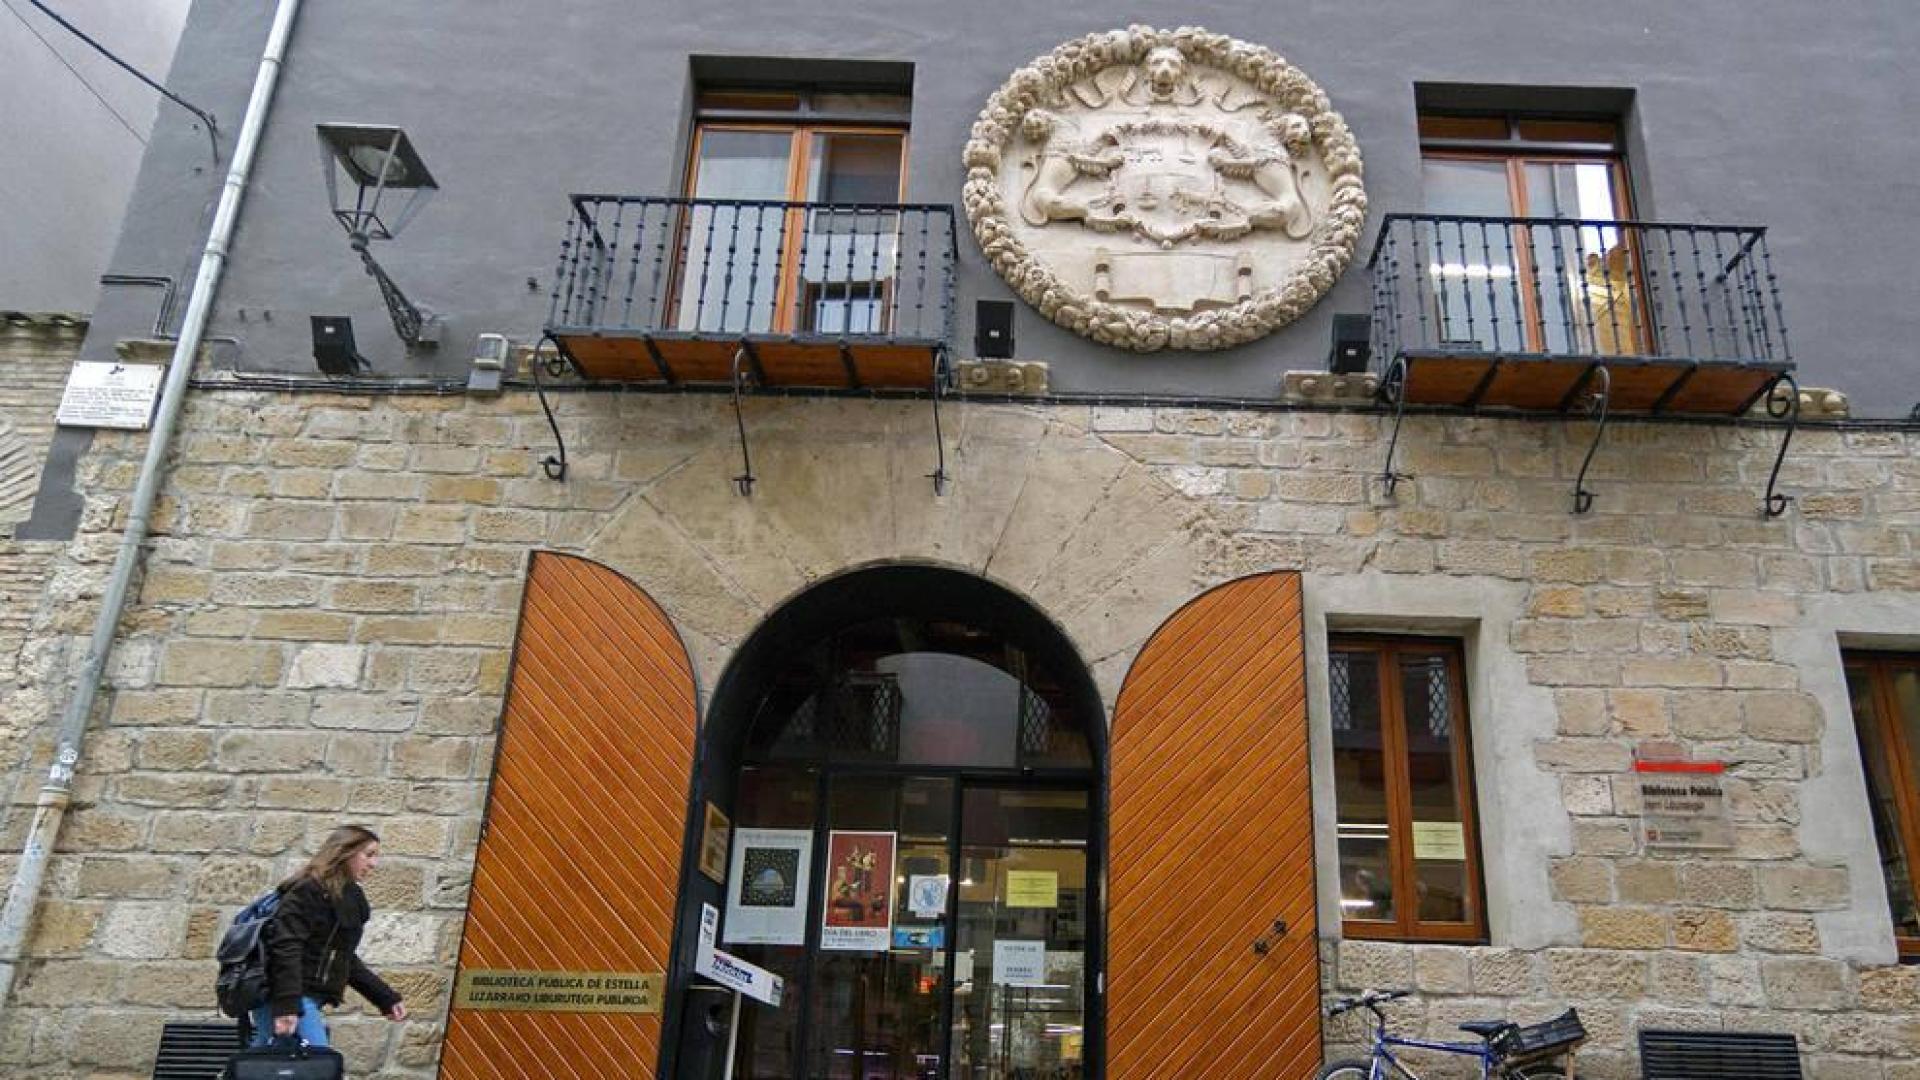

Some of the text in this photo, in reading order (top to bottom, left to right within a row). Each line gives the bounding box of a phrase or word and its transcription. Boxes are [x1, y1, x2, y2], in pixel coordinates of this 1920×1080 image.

[472, 976, 534, 988] BIBLIOTECA
[587, 978, 600, 989] DE
[604, 978, 649, 990] ESTELLA
